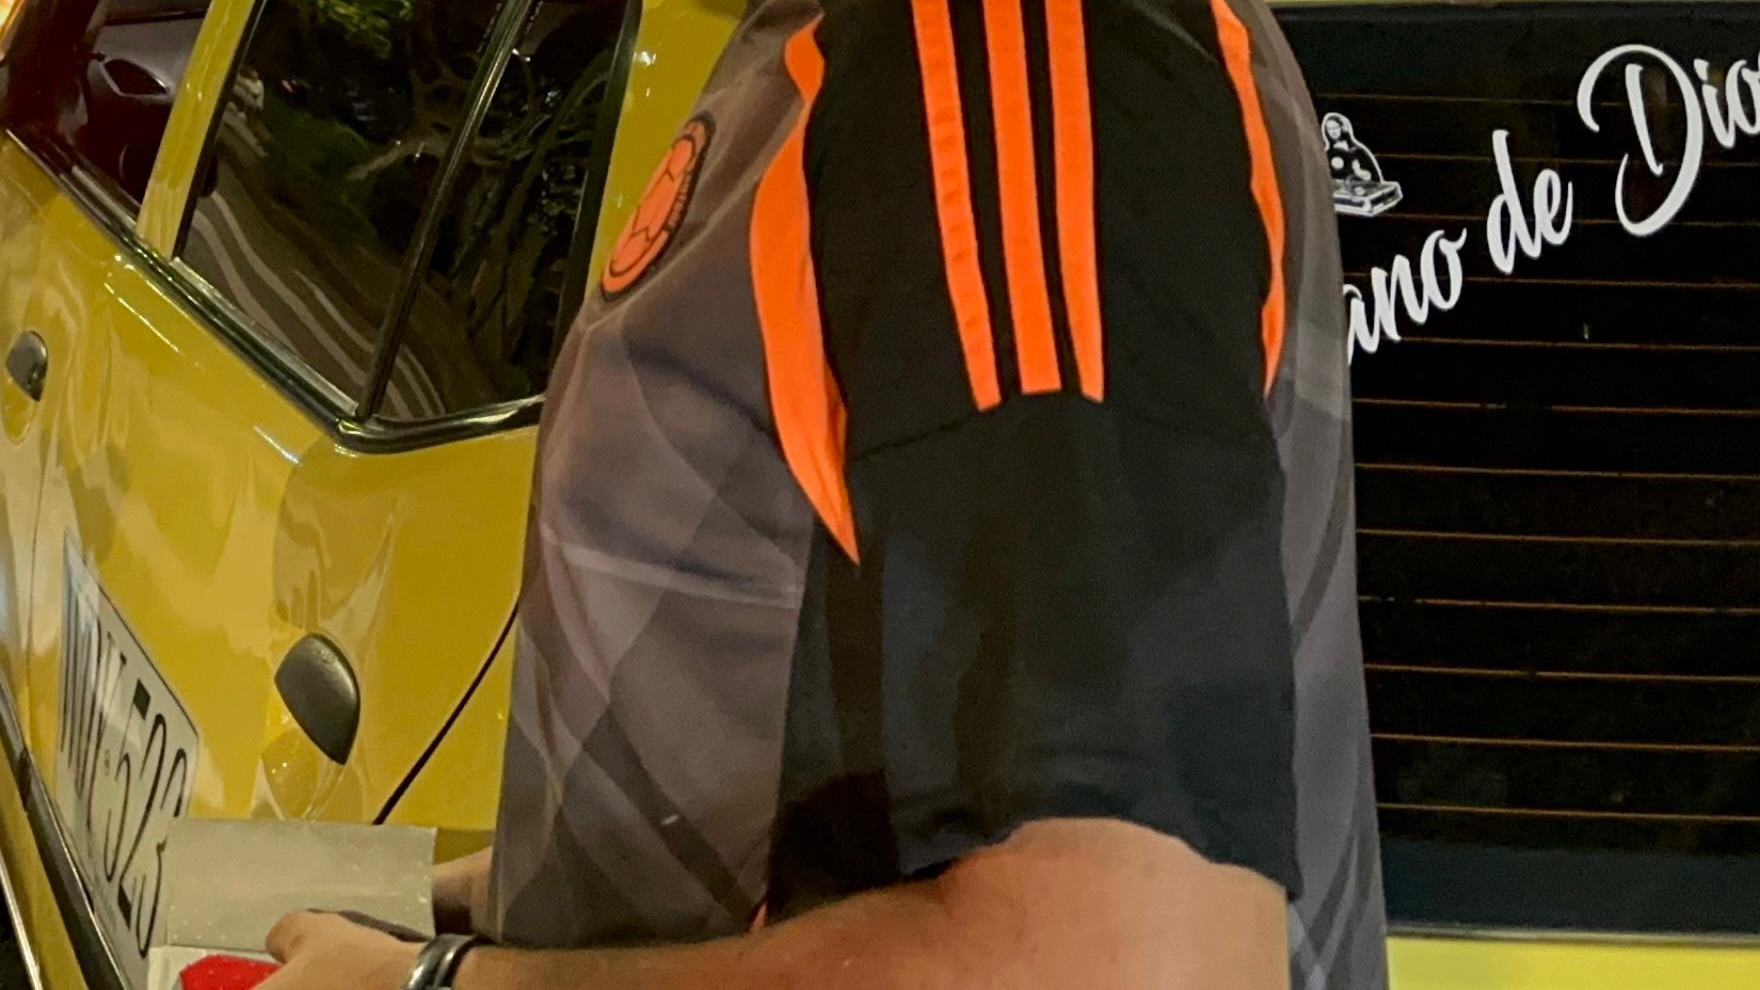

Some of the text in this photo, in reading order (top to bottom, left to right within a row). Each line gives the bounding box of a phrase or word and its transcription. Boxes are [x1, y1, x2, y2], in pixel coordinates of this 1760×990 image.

[1342, 44, 1760, 367] ano de Dio
